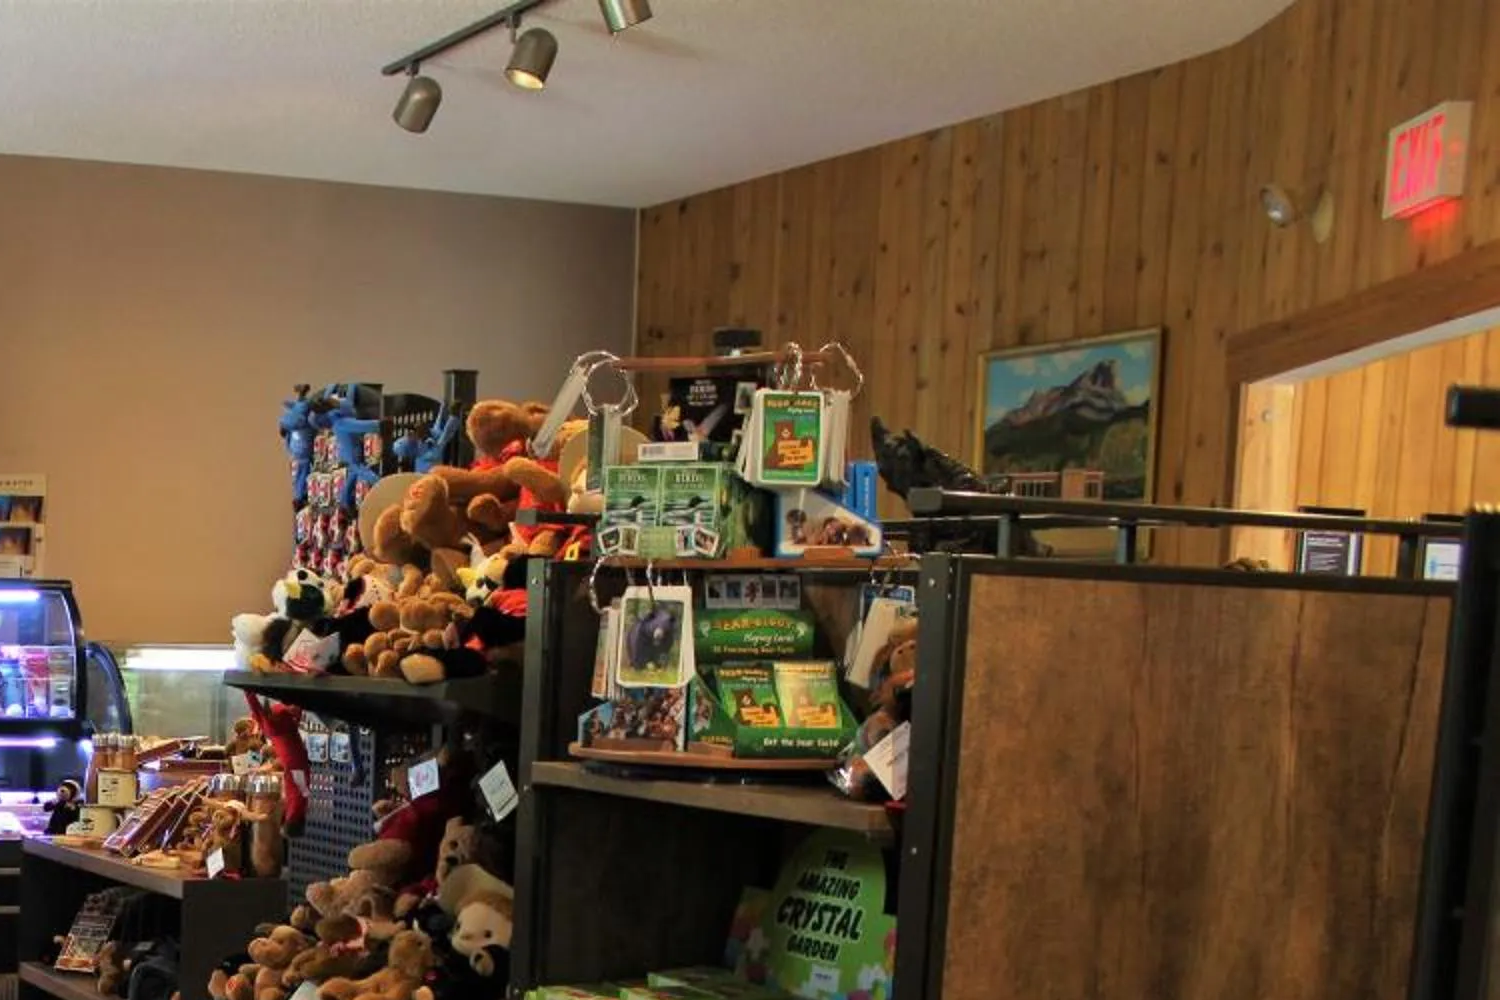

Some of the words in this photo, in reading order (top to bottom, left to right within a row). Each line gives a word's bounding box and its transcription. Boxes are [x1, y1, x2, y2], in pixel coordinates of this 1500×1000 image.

[798, 871, 862, 901] AMAZING
[776, 895, 864, 941] CRYSTAL
[787, 934, 840, 961] GARDEN
